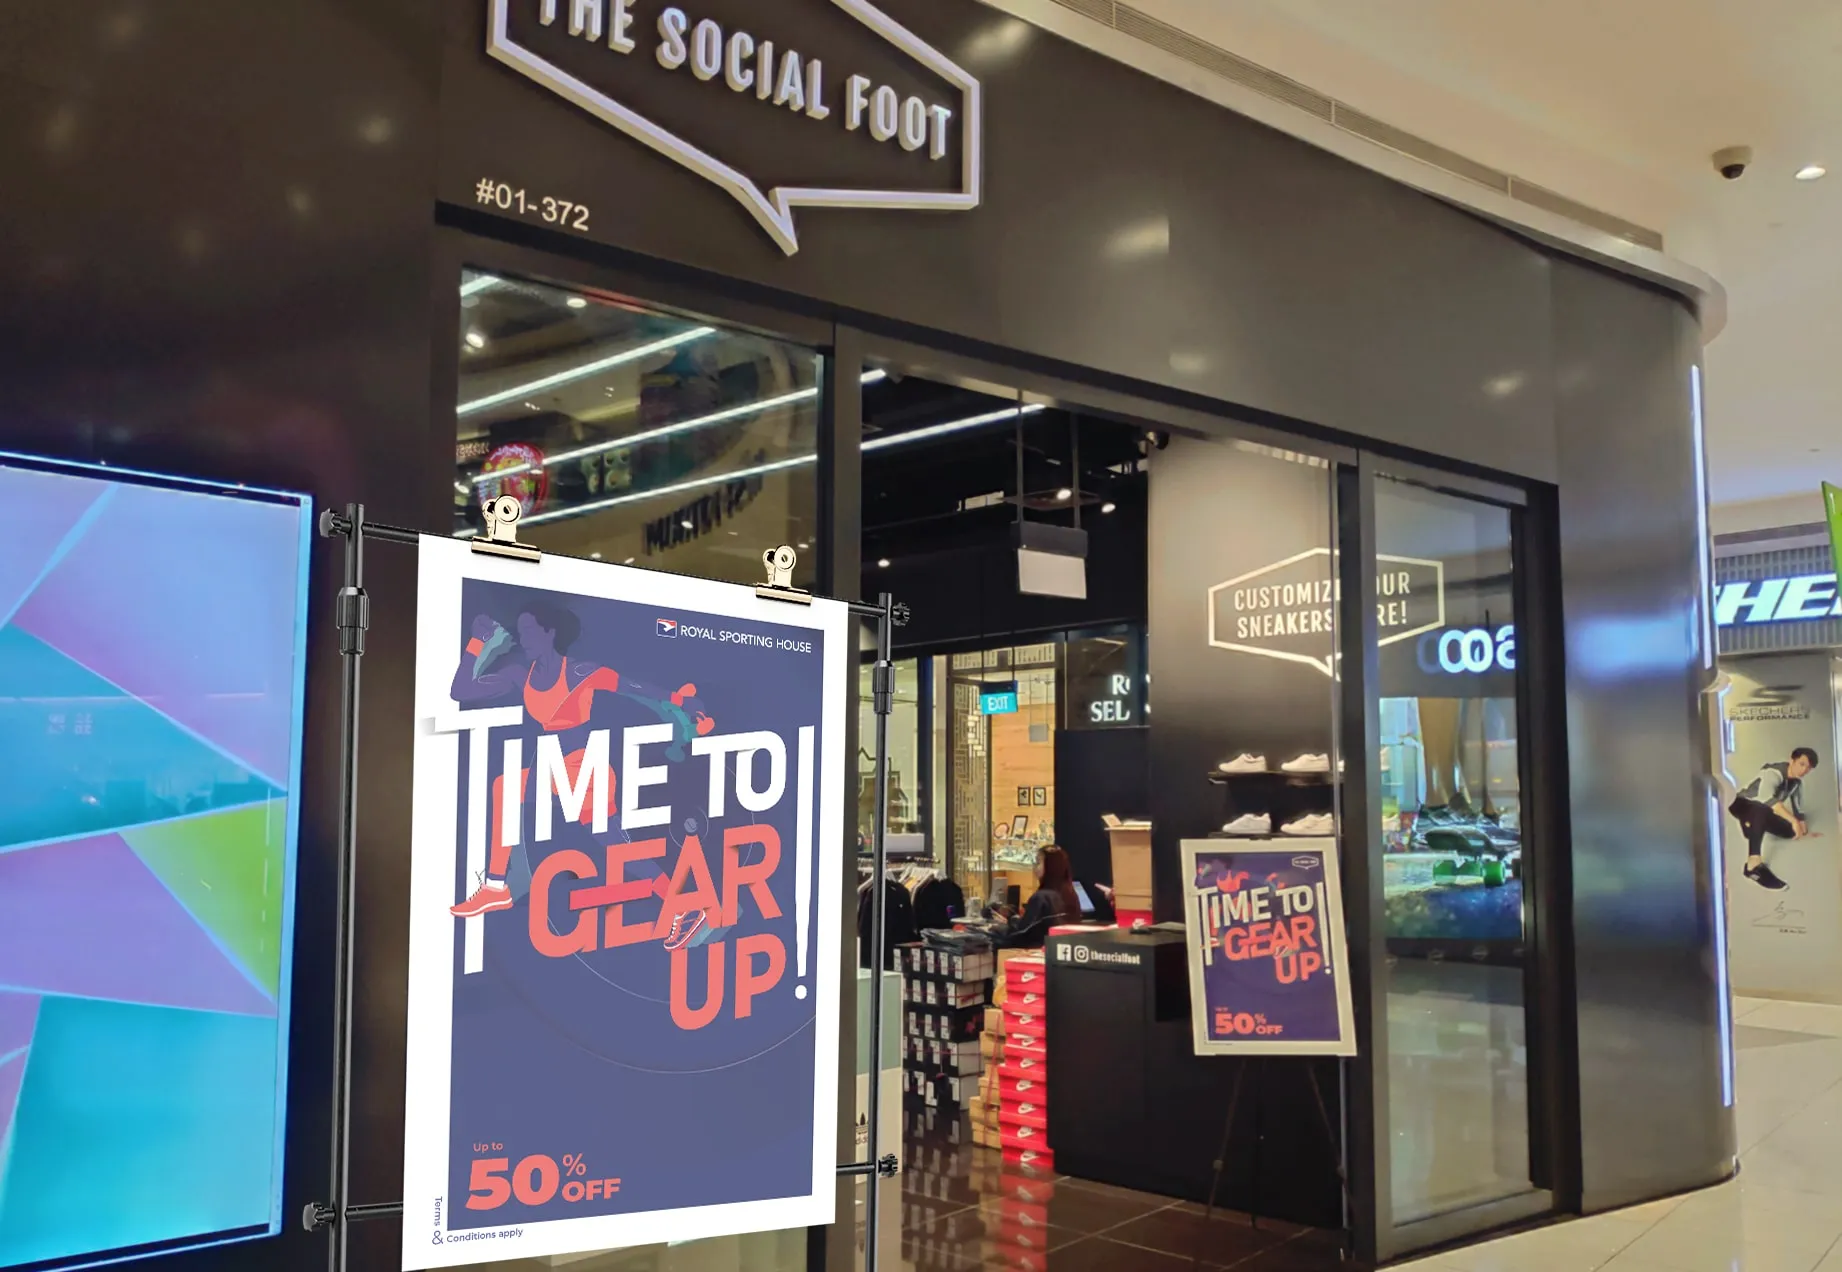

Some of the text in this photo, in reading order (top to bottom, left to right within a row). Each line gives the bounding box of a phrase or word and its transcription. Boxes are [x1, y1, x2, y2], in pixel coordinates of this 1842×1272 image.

[656, 7, 830, 119] SOCIAL
[845, 73, 951, 159] FOOT
[476, 177, 590, 231] #01-372
[1713, 573, 1842, 625] HE
[680, 625, 812, 653] ROYAL SPORTING HOUSE
[1237, 608, 1333, 638] SNEAKERS
[988, 696, 1009, 711] EXIT
[1729, 713, 1811, 721] PERFORMANCE
[435, 705, 787, 975] TIME TO
[528, 823, 783, 958] GEAR
[1191, 885, 1314, 966] TIME TO
[1225, 915, 1317, 961] GEAR
[1255, 1025, 1283, 1035] OFF
[473, 1141, 504, 1153] Up to
[562, 1178, 622, 1202] OFF
[433, 1196, 443, 1226] Terms
[447, 1231, 496, 1243] Conditions
[499, 1228, 524, 1239] apply
